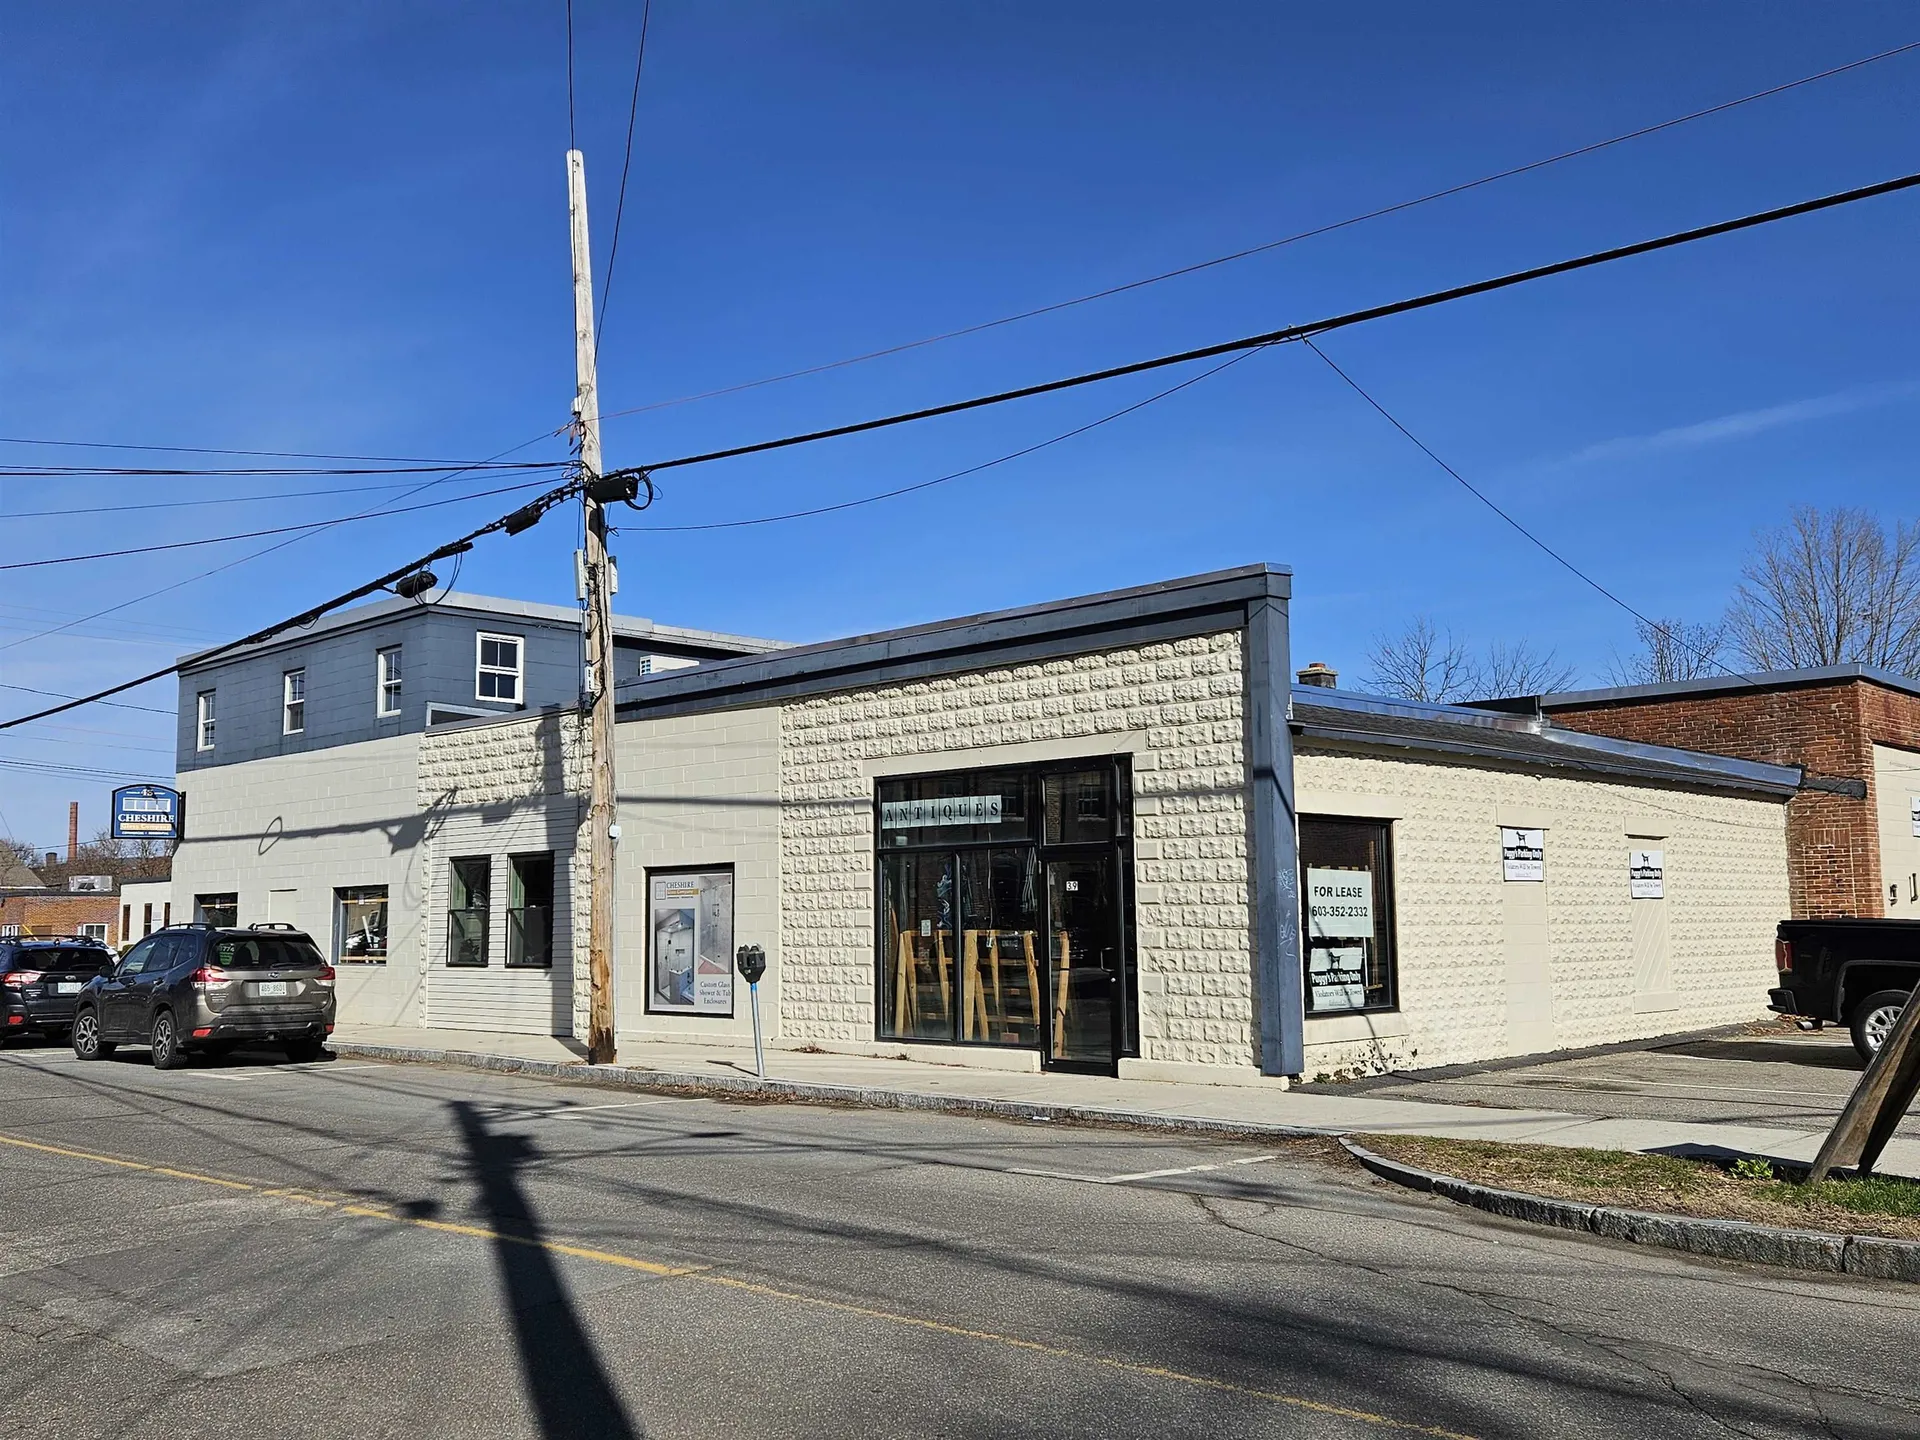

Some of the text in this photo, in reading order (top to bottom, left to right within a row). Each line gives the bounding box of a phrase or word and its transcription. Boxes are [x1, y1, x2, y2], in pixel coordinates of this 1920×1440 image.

[884, 801, 998, 822] ANTIQUES
[117, 813, 175, 823] CHESHIRE
[1517, 848, 1533, 860] Parking
[1532, 849, 1542, 860] Only
[1067, 881, 1077, 890] 39
[1314, 886, 1363, 898] FOR LEASE
[1311, 905, 1368, 917] 603-352-2332
[1330, 971, 1351, 984] Parking
[1349, 970, 1361, 983] Only
[722, 989, 732, 997] Tub
[1314, 989, 1334, 997] Violators
[1334, 988, 1344, 996] Will
[1349, 988, 1362, 996] Towed
